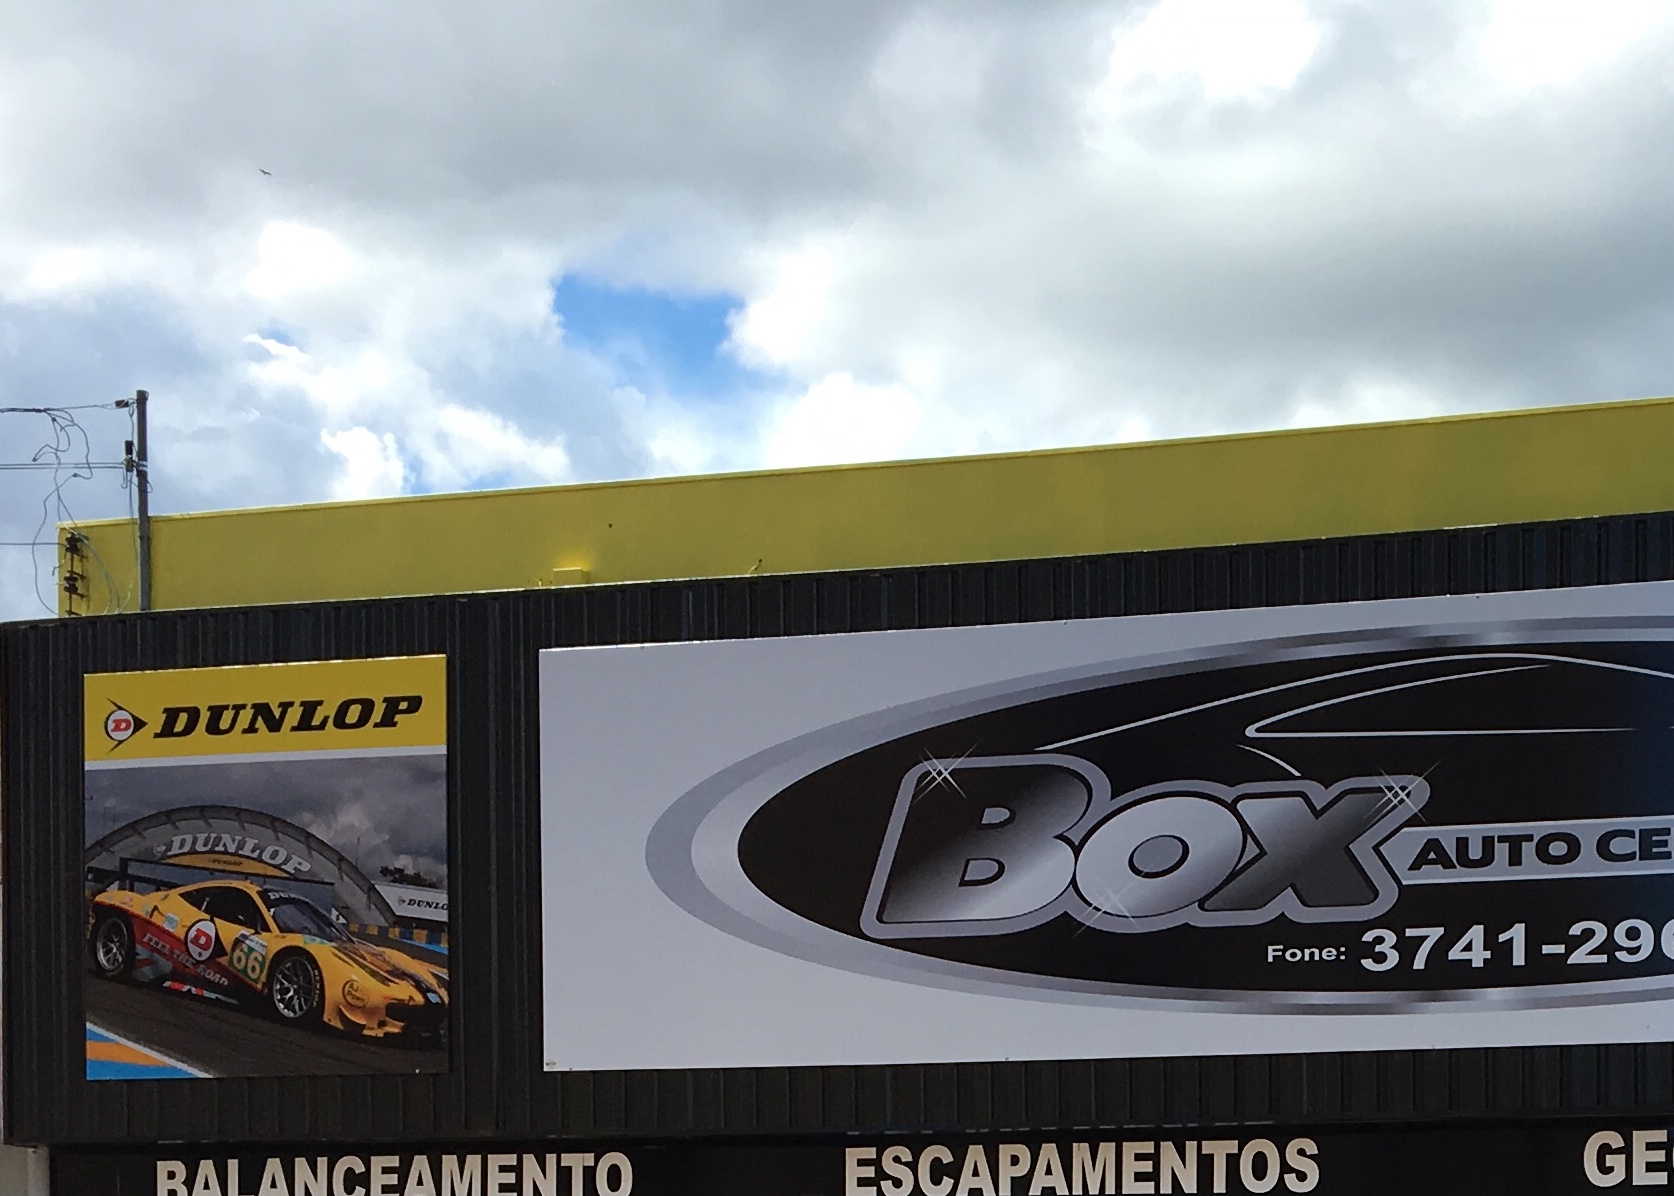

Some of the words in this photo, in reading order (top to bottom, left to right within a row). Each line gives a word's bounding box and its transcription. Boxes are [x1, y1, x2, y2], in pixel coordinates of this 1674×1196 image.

[152, 695, 423, 739] DUNLOP
[165, 832, 312, 874] DUNLOP
[1406, 830, 1581, 871] AUTO
[232, 946, 262, 980] 66
[1266, 942, 1346, 964] Fone:
